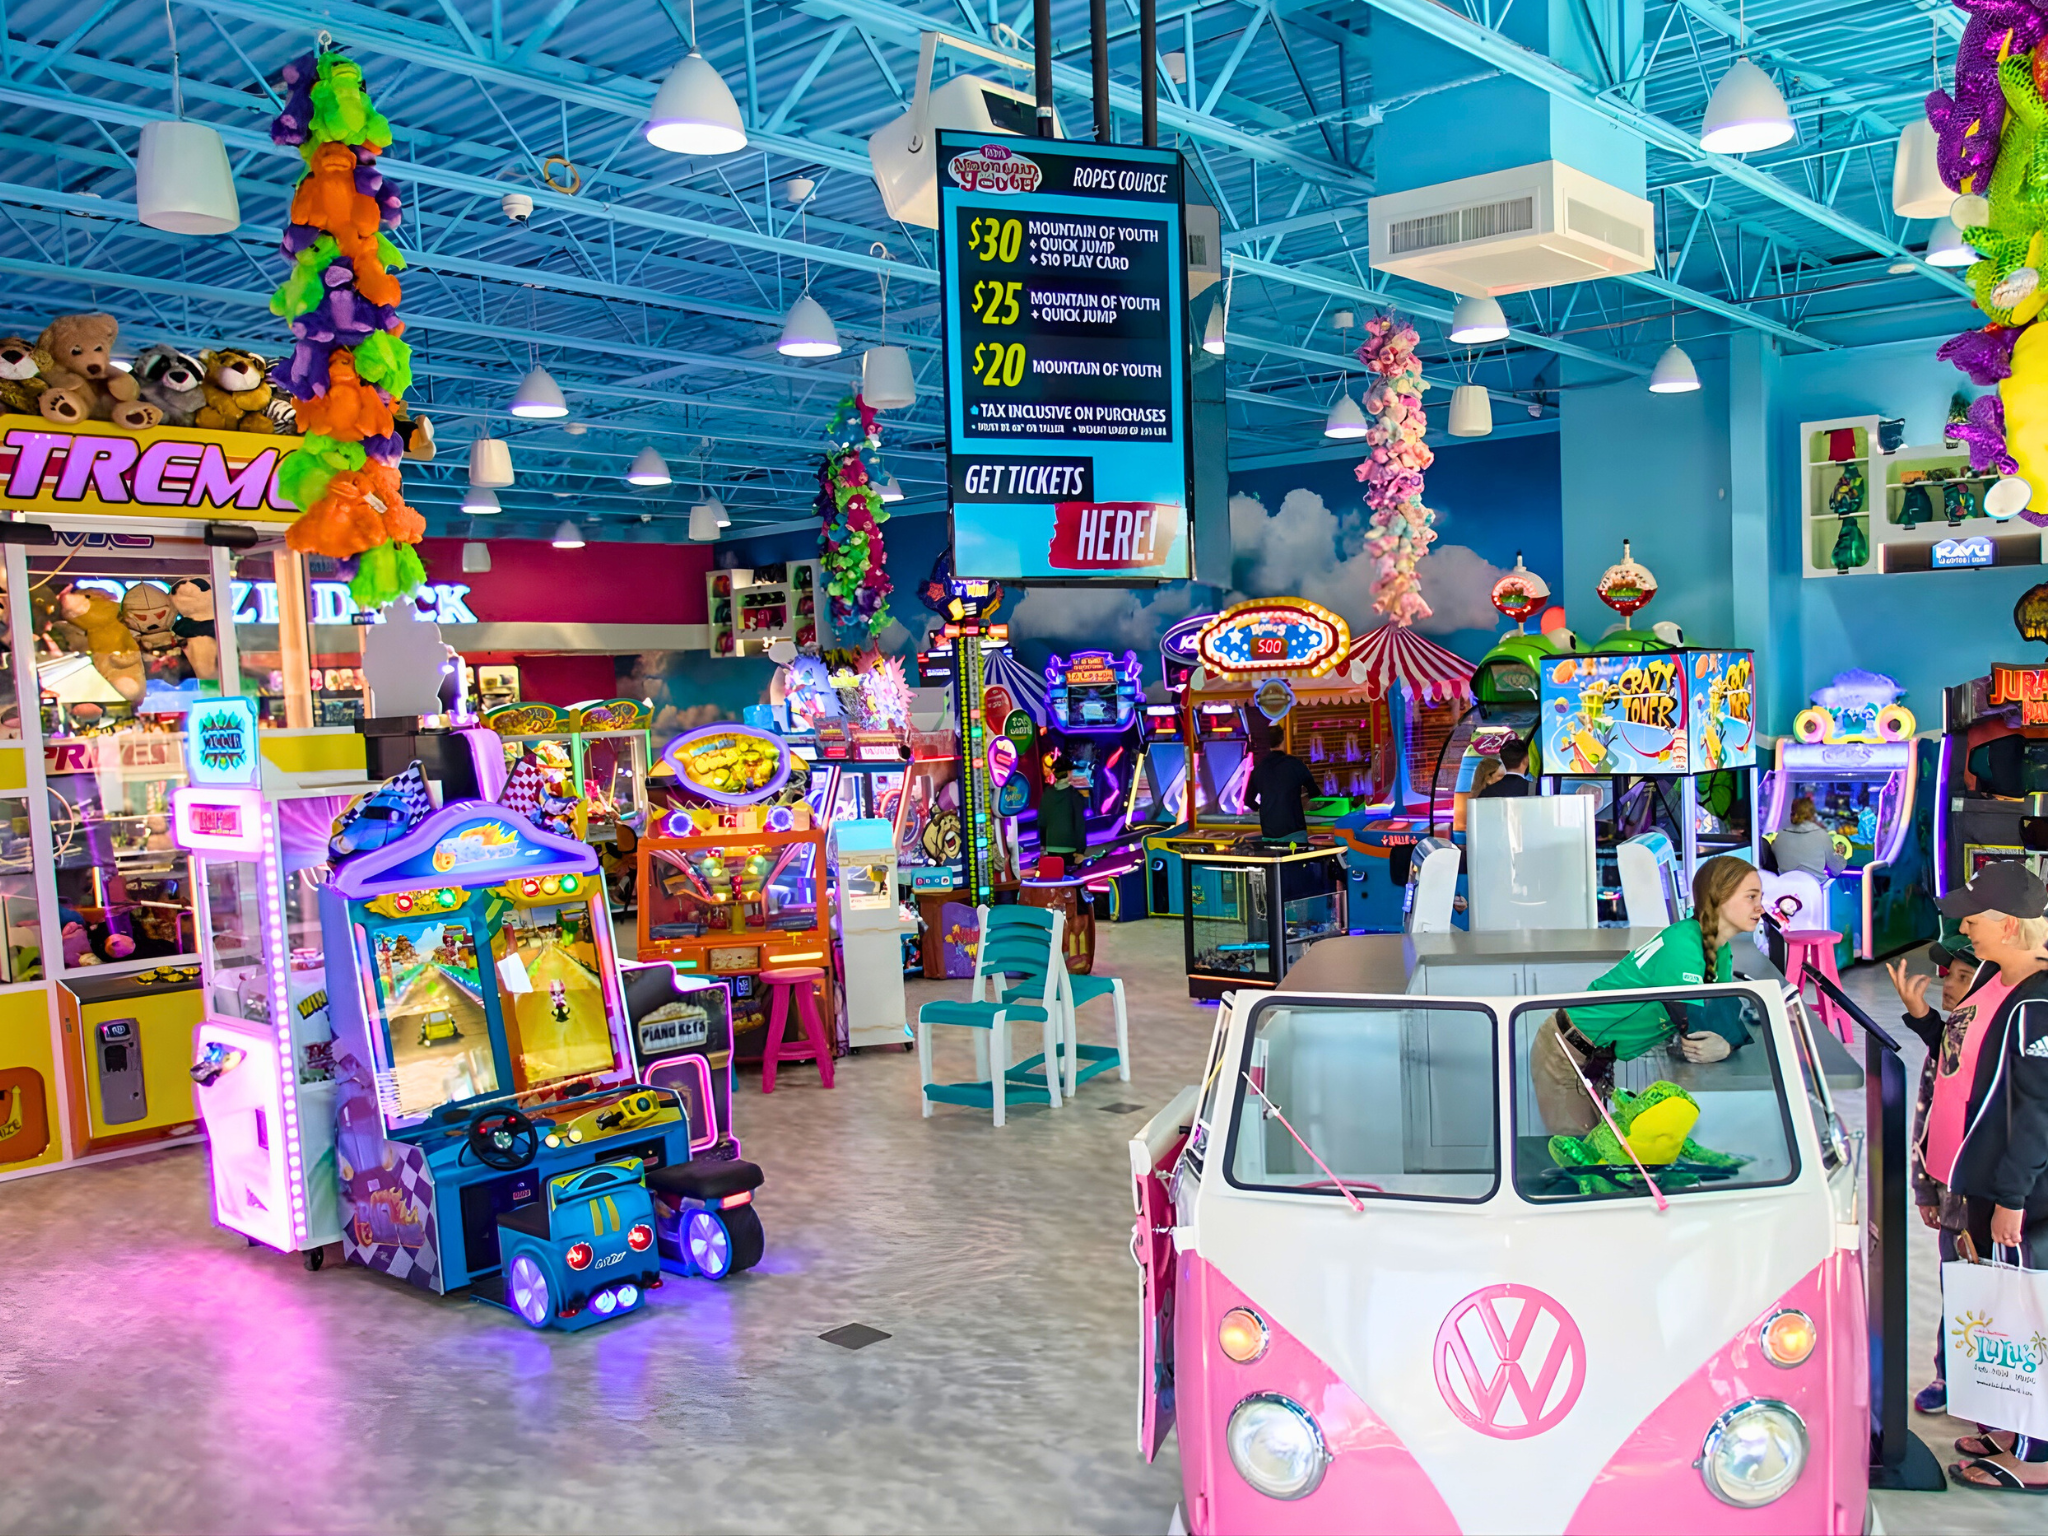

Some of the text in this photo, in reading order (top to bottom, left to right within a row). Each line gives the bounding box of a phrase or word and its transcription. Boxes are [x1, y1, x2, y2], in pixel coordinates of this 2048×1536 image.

[1073, 167, 1169, 194] ROPES COURSE
[968, 217, 1023, 263] $30
[1028, 220, 1159, 243] MOUNTAIN OF YOUTH
[1040, 237, 1078, 253] QUICK
[1080, 239, 1116, 254] JUMP
[1063, 254, 1094, 269] PLAY
[1096, 256, 1130, 271] CARD
[971, 280, 1023, 326] $25
[1030, 291, 1161, 311] MOUNTAIN OF YOUTH
[1042, 307, 1081, 322] QUICK
[1082, 310, 1117, 324] JUMP
[972, 342, 1026, 387] $20
[1032, 359, 1162, 378] MOUNTAIN OF YOUTH
[980, 403, 1167, 422] TAX INCLUSIVE ON PURCHASES
[965, 464, 1085, 495] GET TICKETS
[1077, 509, 1159, 561] HERE!
[1258, 639, 1283, 654] 500
[1619, 659, 1676, 694] CRAZY
[1622, 694, 1676, 728] TOWER
